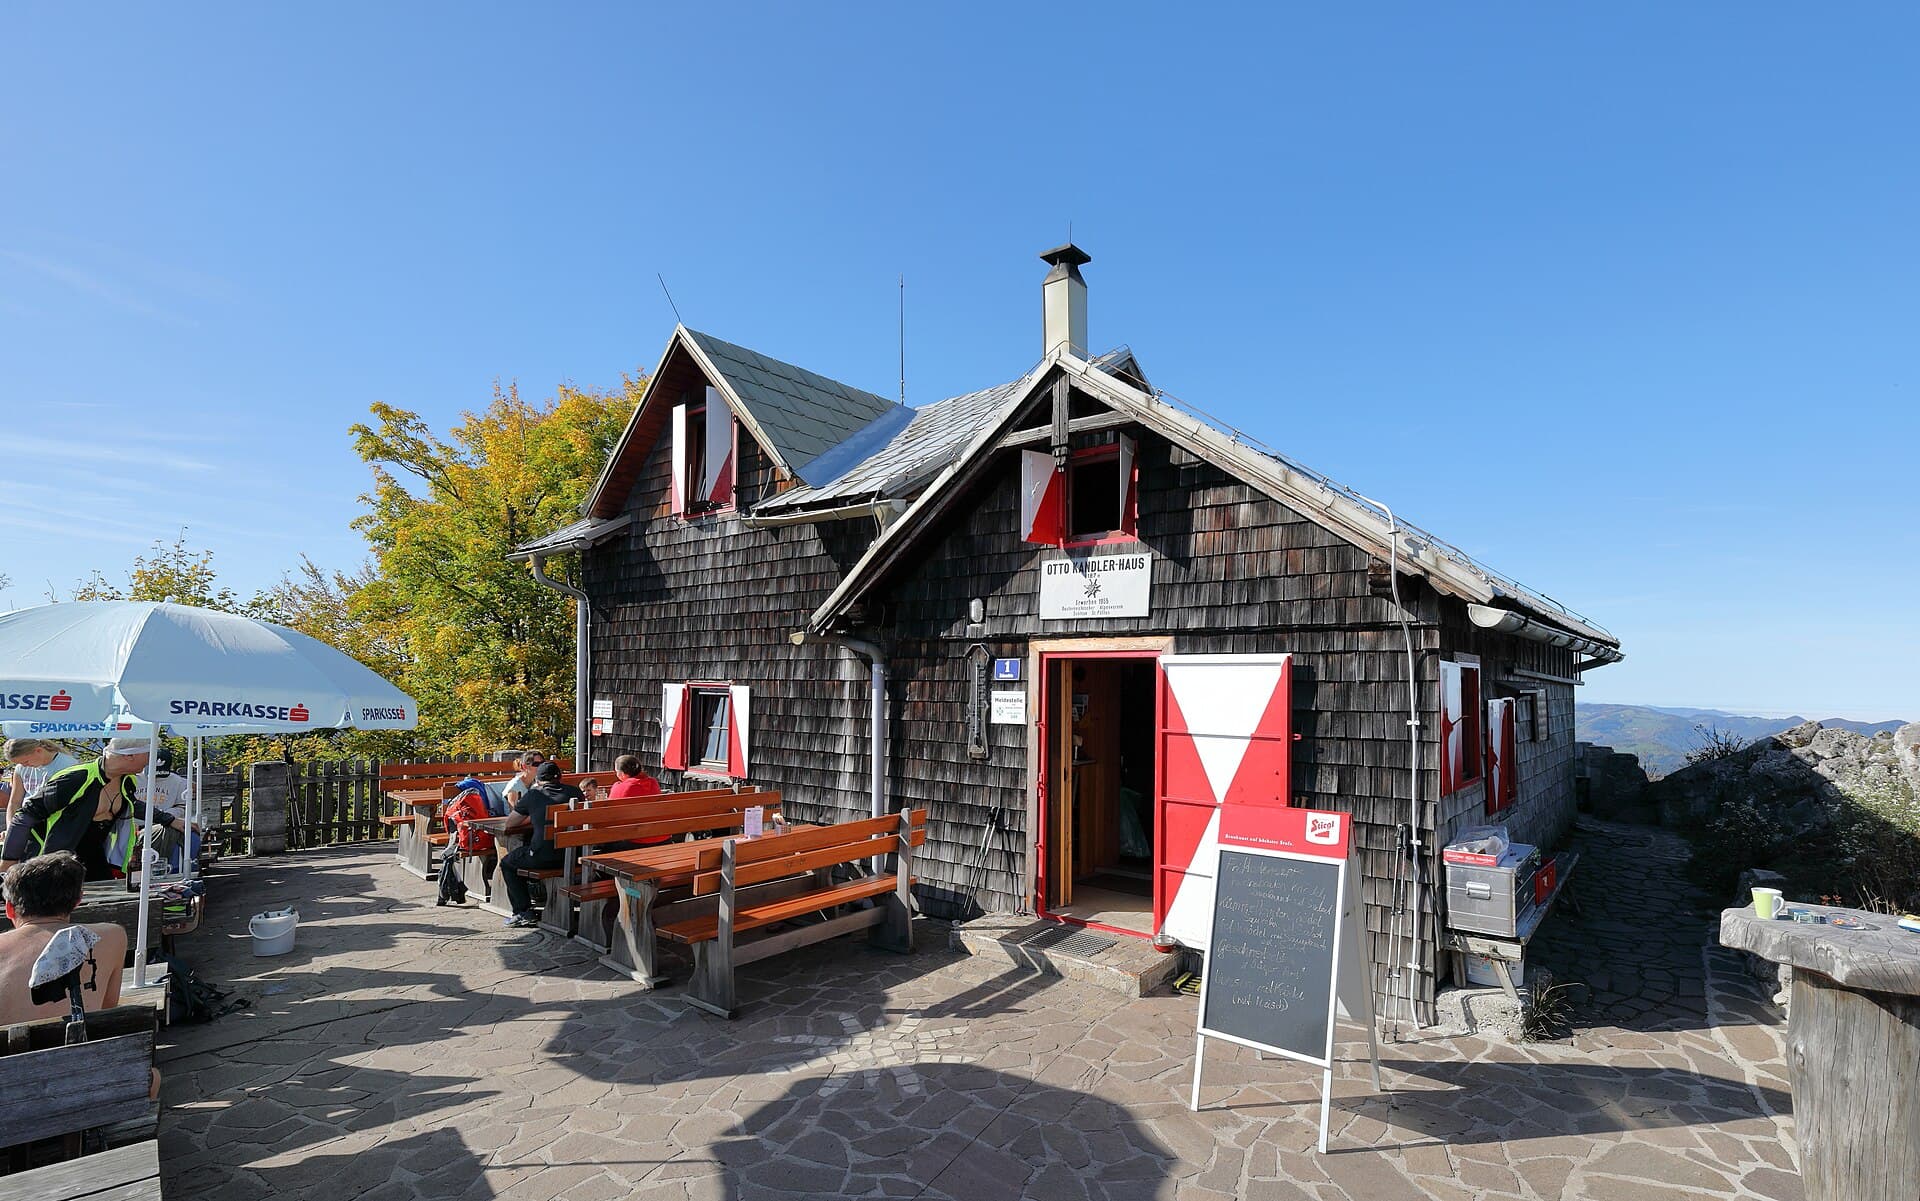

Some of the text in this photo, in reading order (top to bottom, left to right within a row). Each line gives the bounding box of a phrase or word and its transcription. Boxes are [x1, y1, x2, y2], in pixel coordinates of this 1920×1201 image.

[1047, 557, 1145, 576] OTTO KANDLER-HAUS
[1004, 660, 1010, 673] 1
[170, 700, 289, 721] SPARKASSE
[1310, 818, 1335, 833] Stiegl
